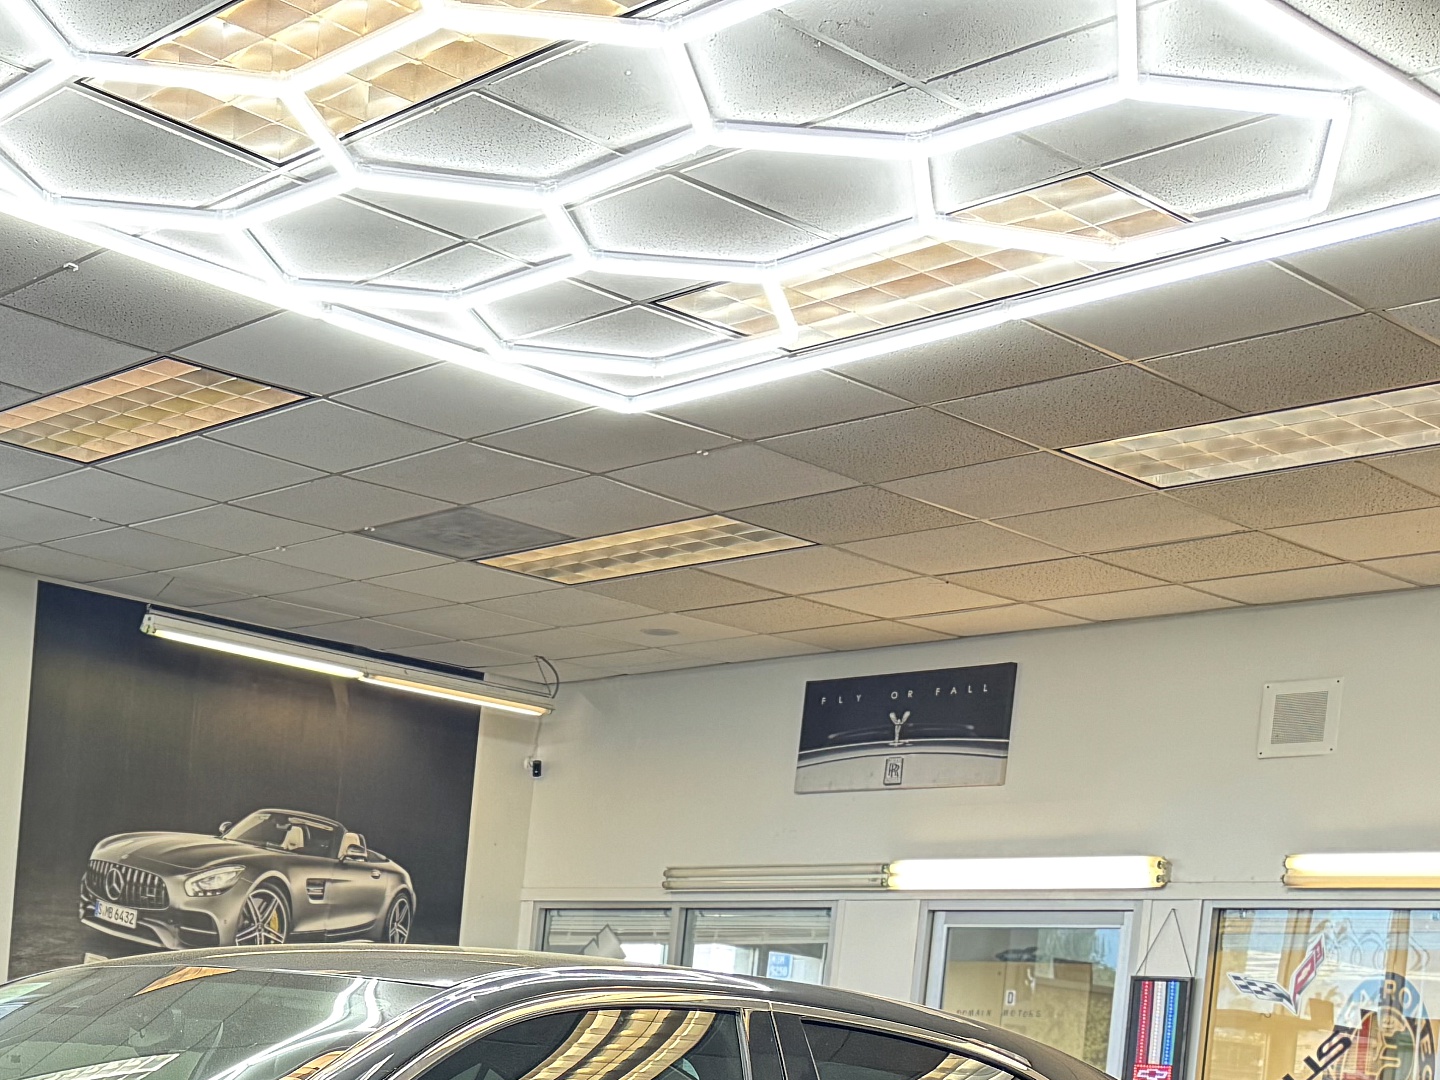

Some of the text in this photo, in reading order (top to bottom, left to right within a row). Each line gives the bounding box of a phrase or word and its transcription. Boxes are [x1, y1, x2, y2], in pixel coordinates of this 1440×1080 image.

[821, 683, 988, 705] FLY OR FALL
[114, 908, 135, 925] 6432
